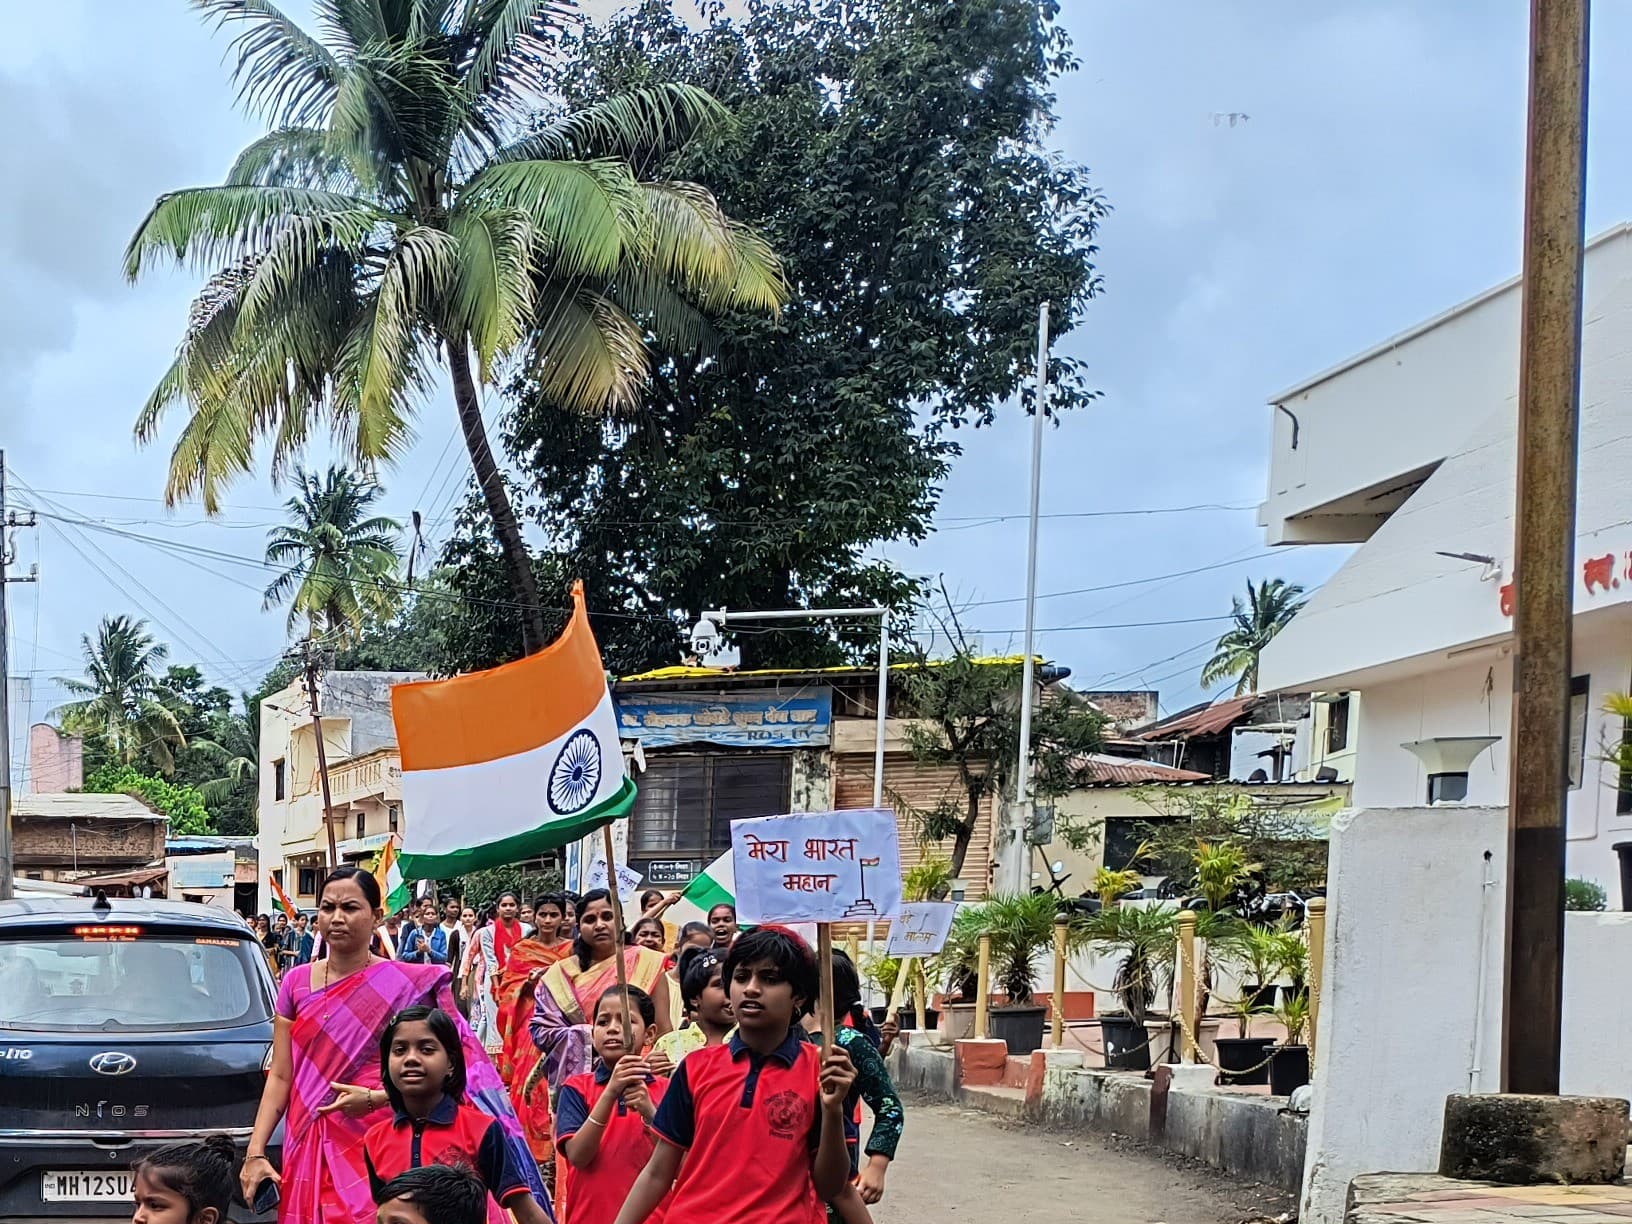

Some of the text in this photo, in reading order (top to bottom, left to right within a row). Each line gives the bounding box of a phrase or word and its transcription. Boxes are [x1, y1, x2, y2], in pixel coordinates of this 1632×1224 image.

[744, 834, 858, 862] मेरा भारत
[783, 874, 838, 893] महान
